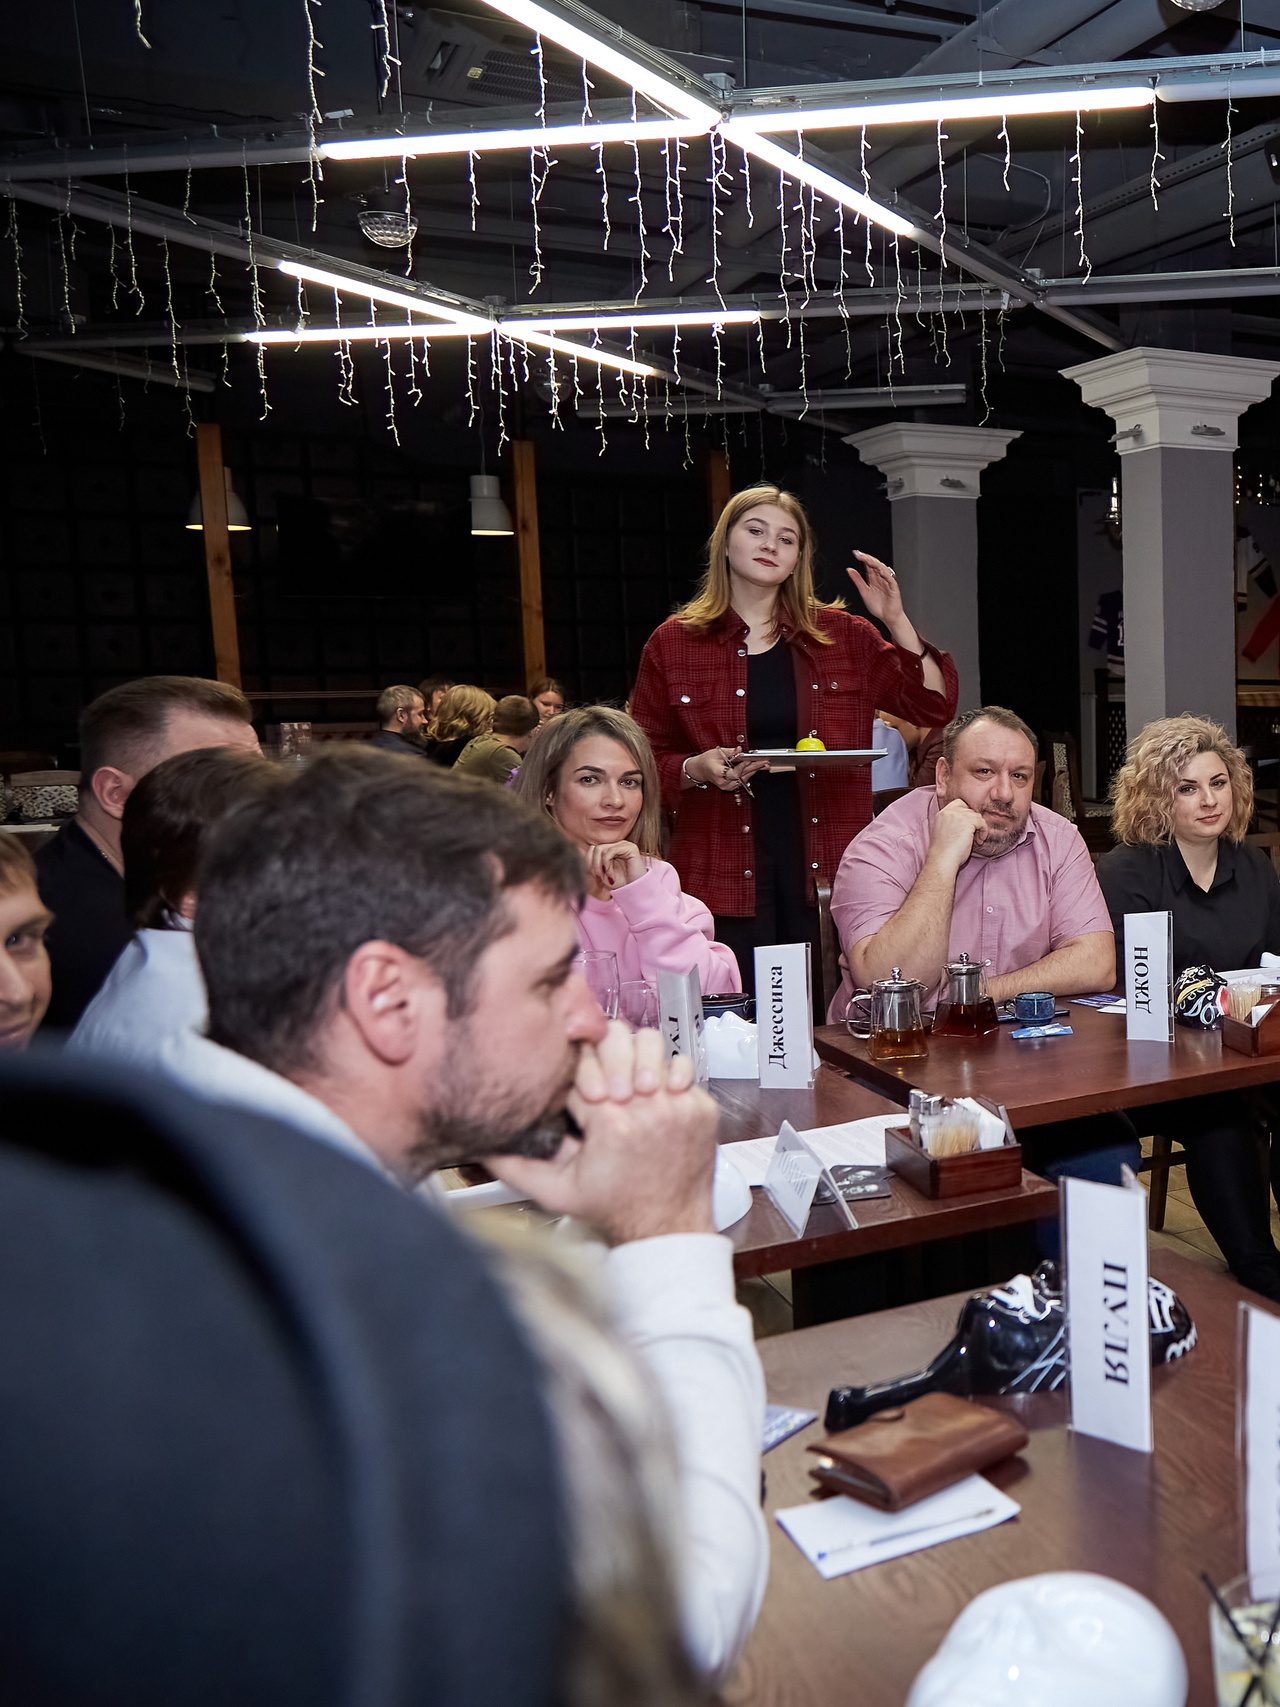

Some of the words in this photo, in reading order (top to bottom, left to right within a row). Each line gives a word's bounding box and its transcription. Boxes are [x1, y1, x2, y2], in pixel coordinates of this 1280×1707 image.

[768, 965, 789, 1070] Джессика
[1133, 946, 1153, 1015] ДЖОН
[1102, 1259, 1130, 1388] ПУЛЯ
